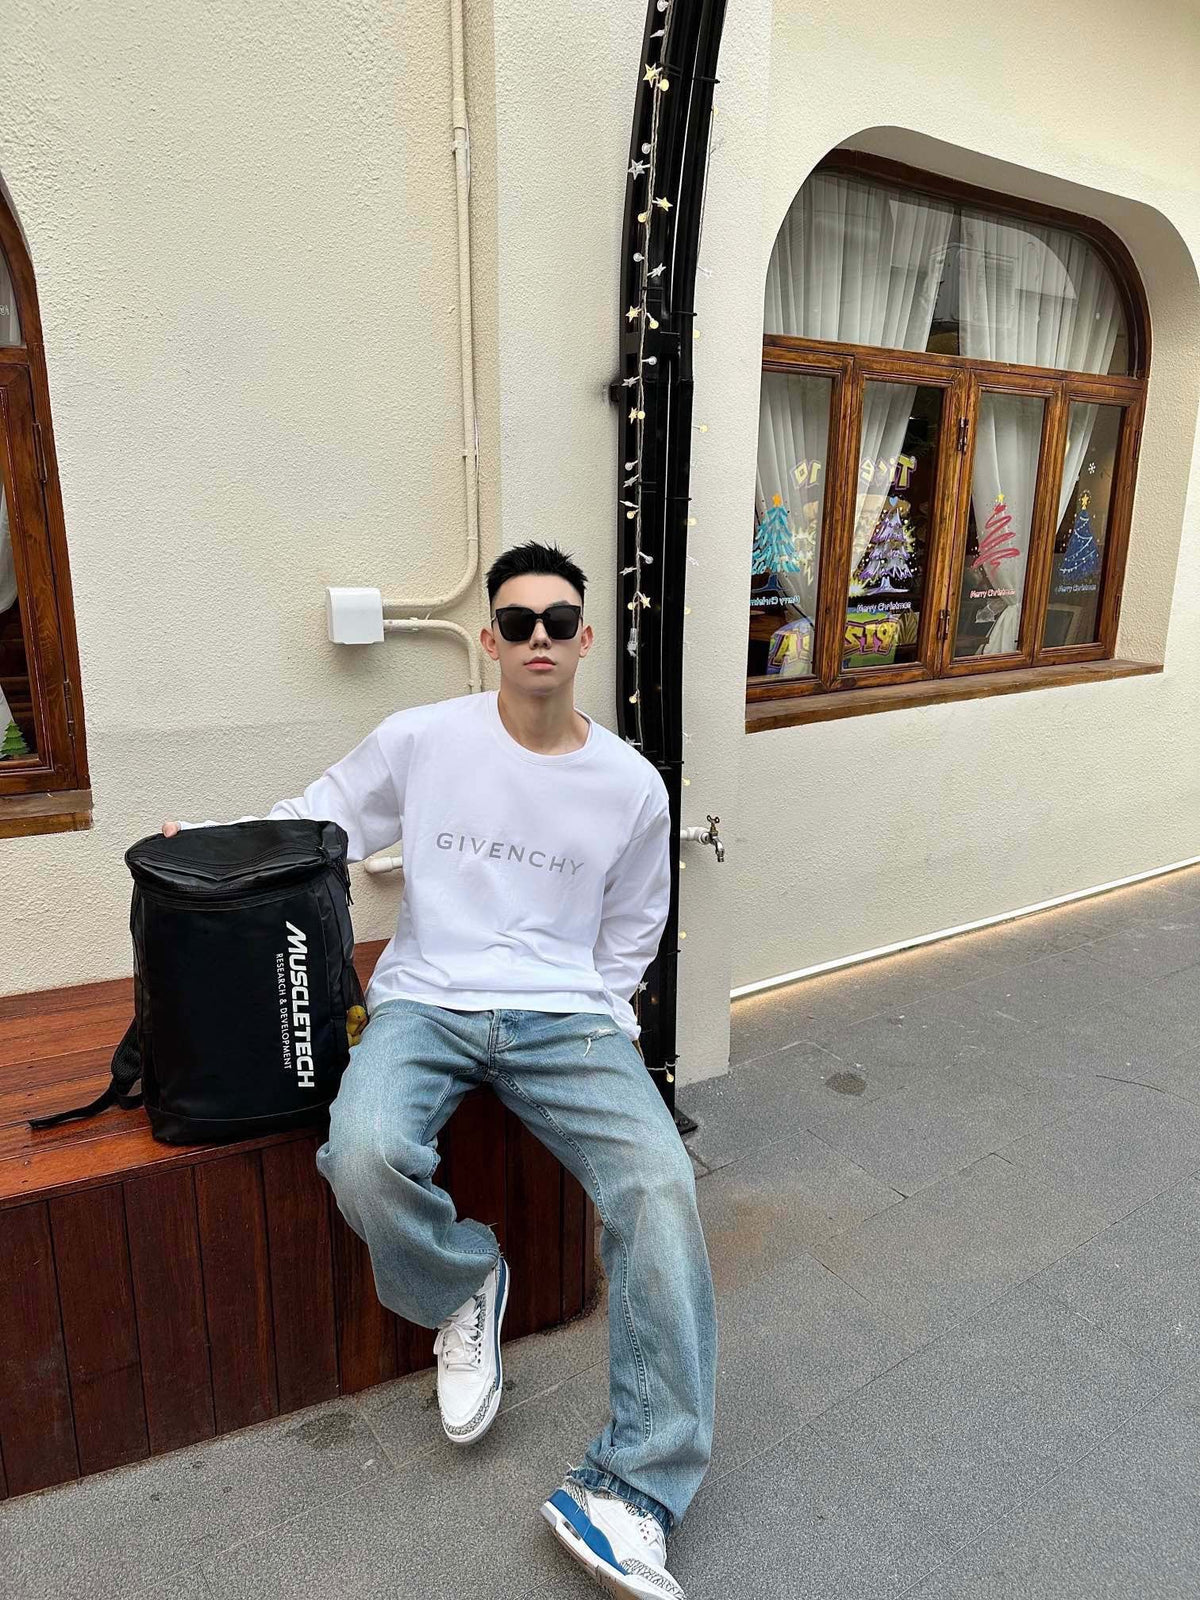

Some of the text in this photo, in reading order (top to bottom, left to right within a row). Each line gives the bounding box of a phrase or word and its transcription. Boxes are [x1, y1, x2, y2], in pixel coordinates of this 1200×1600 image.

[436, 832, 585, 875] GIVENCHY
[275, 953, 287, 996] RESEARCH
[285, 920, 315, 1088] MUSCLETECH
[279, 1008, 292, 1069] DEVELOPMENT
